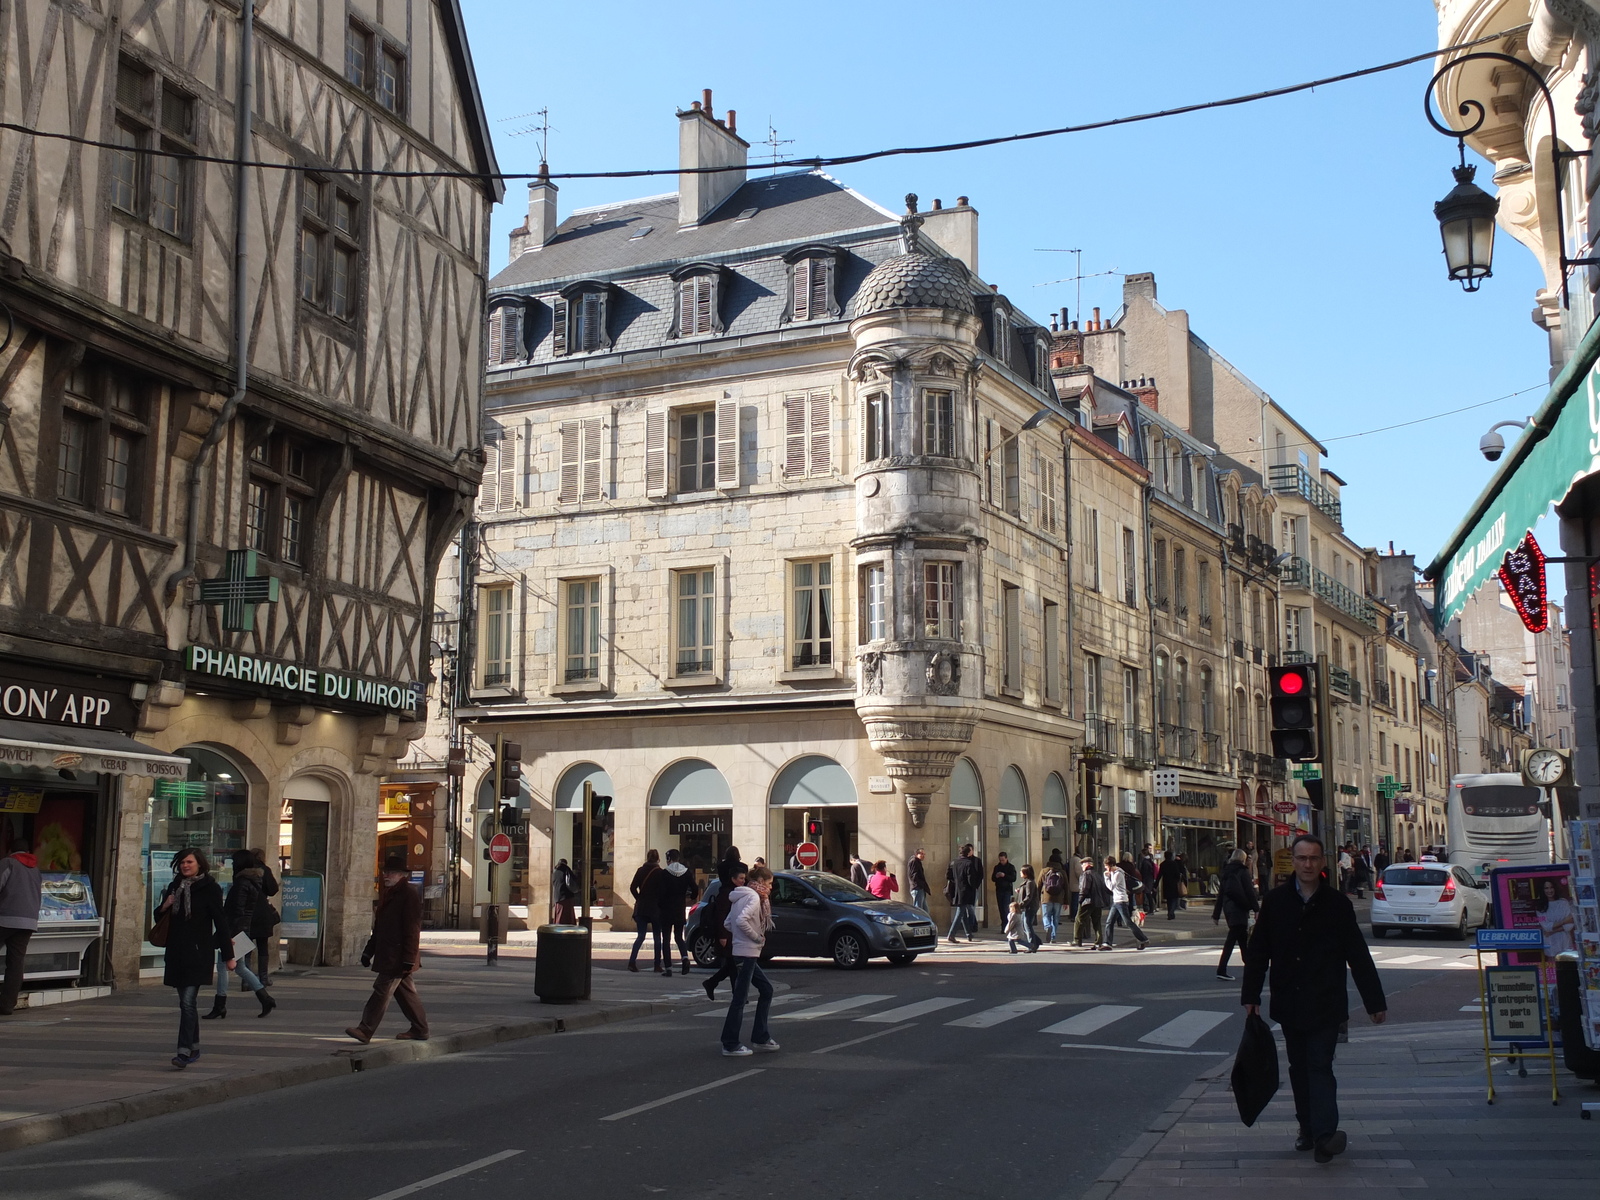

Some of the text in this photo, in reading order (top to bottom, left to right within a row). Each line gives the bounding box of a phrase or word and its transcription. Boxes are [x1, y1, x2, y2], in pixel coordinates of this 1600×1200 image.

[192, 645, 417, 711] PHARMACIE DU MIROIR
[0, 684, 111, 726] ON' APP
[101, 758, 127, 771] KEBAB
[146, 762, 182, 776] BOISSON
[677, 817, 724, 832] minelli
[1481, 932, 1538, 941] LE BIEN PUBLIC
[1491, 983, 1535, 992] L'immobilier
[1491, 995, 1537, 1004] d'entreprise
[1499, 1008, 1531, 1017] se porte
[1508, 1020, 1524, 1029] bien
